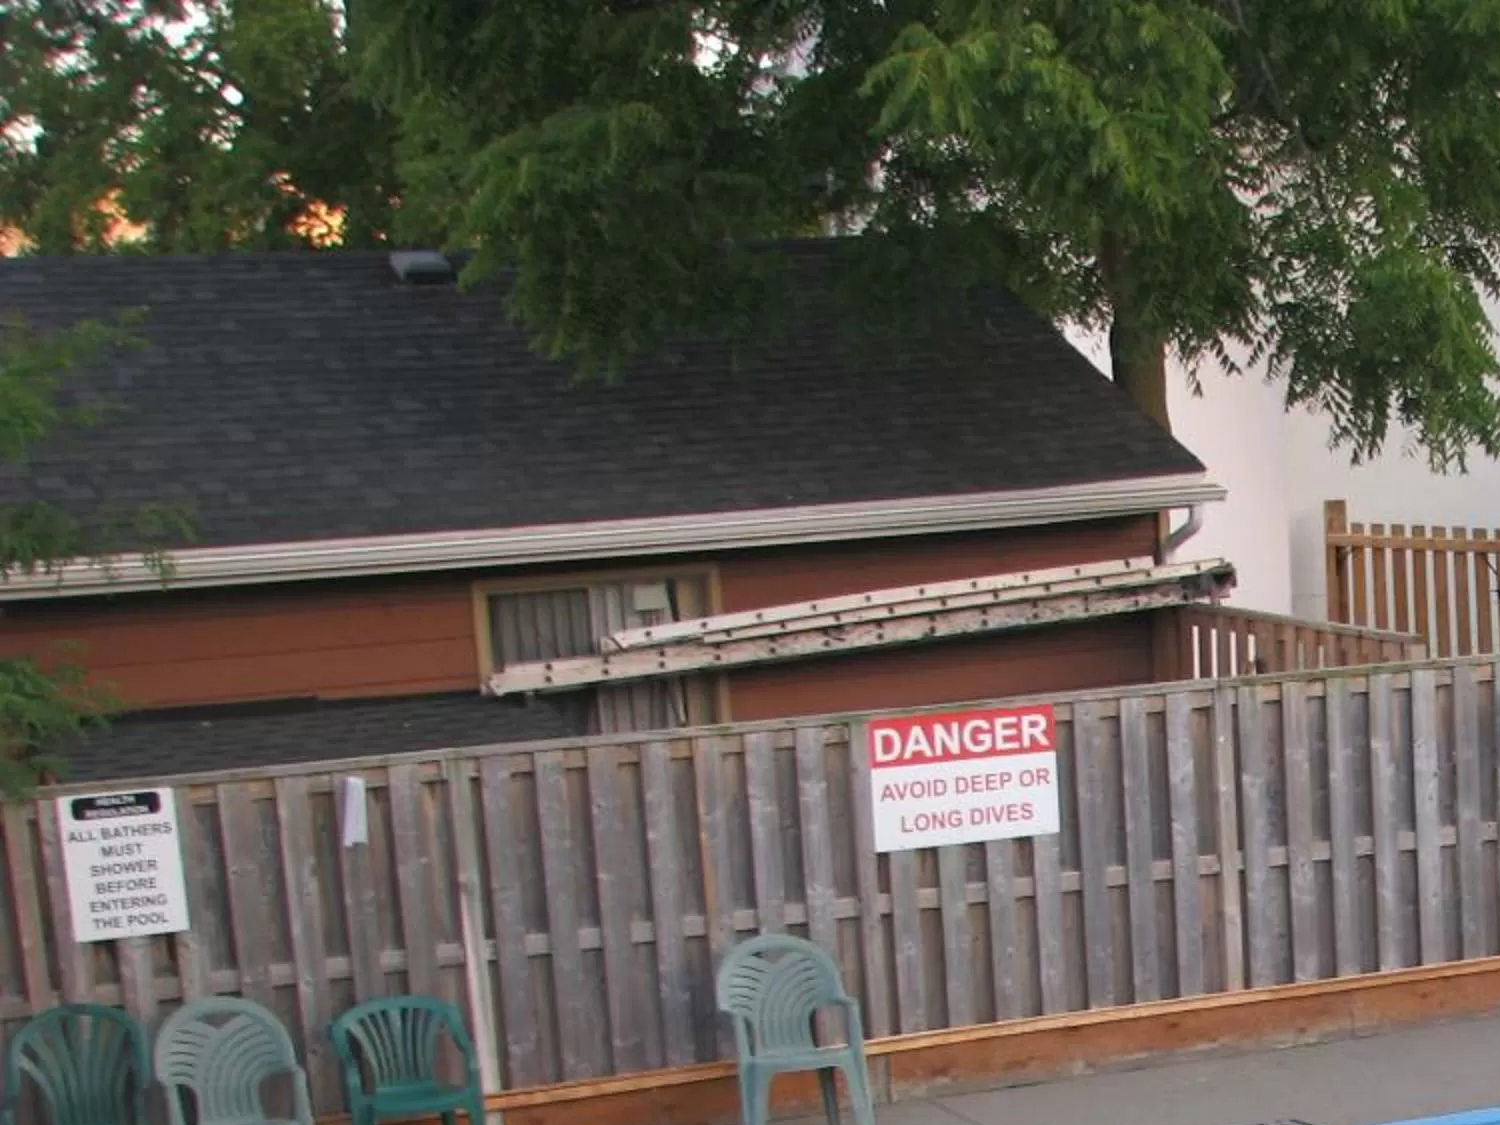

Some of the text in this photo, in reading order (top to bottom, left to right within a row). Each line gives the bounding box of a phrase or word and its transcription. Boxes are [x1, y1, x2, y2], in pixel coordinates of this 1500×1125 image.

[873, 714, 1049, 762] DANGER
[880, 768, 1050, 802] AVOID DEEP OR
[901, 803, 1033, 833] LONG DIVES
[68, 822, 172, 843] ALL BATHERS
[100, 843, 142, 856] MUST
[90, 859, 158, 877] SHOWER
[95, 877, 157, 894] BEFORE
[89, 893, 168, 913] ENTERING
[92, 912, 169, 929] THE POOL
